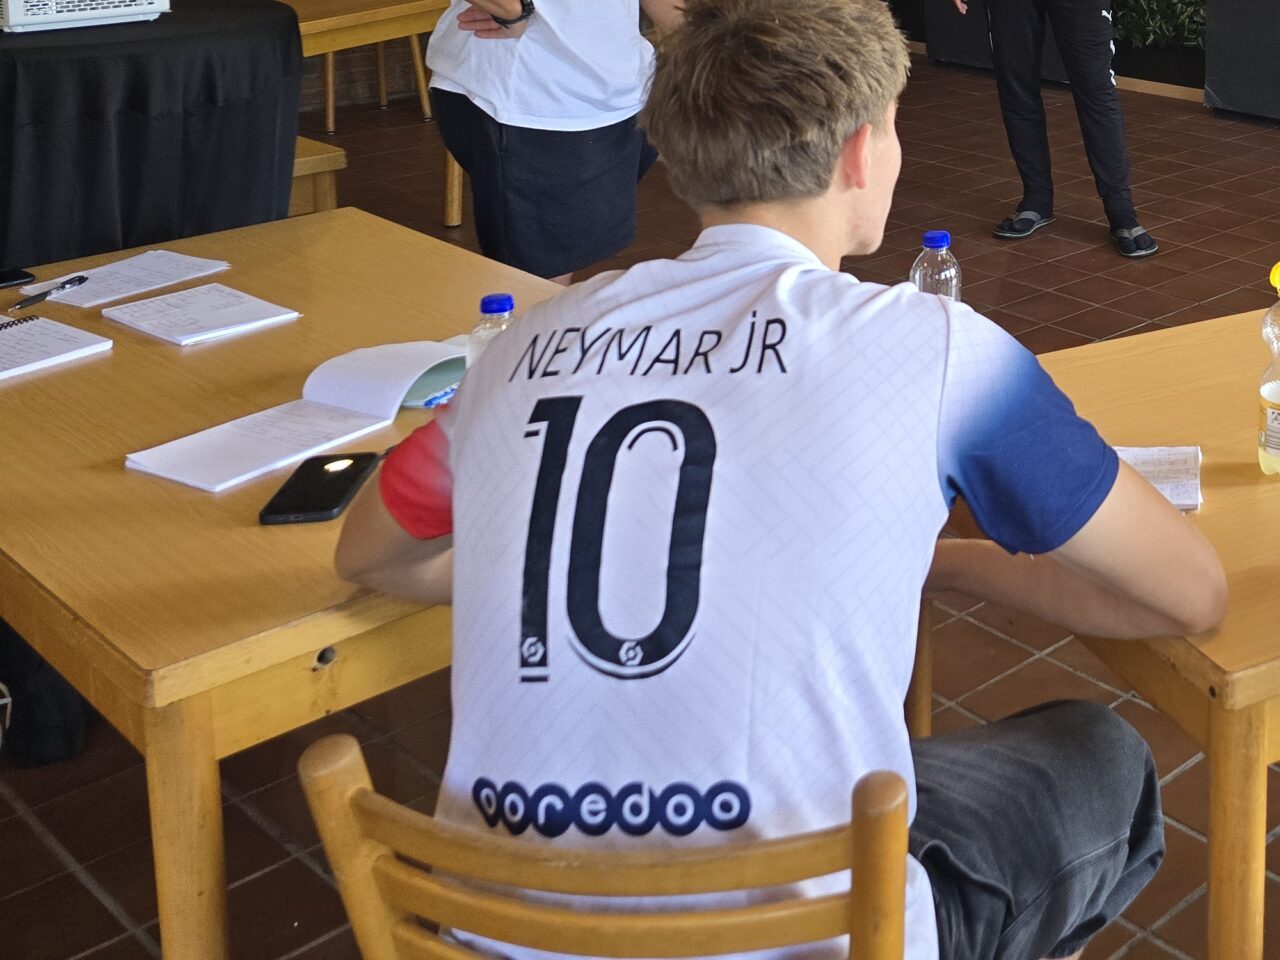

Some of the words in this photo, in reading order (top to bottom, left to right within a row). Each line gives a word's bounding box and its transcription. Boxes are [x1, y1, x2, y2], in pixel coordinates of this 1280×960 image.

[509, 324, 722, 382] NEYMAR
[521, 395, 717, 683] 10
[478, 783, 743, 826] ooredoo
